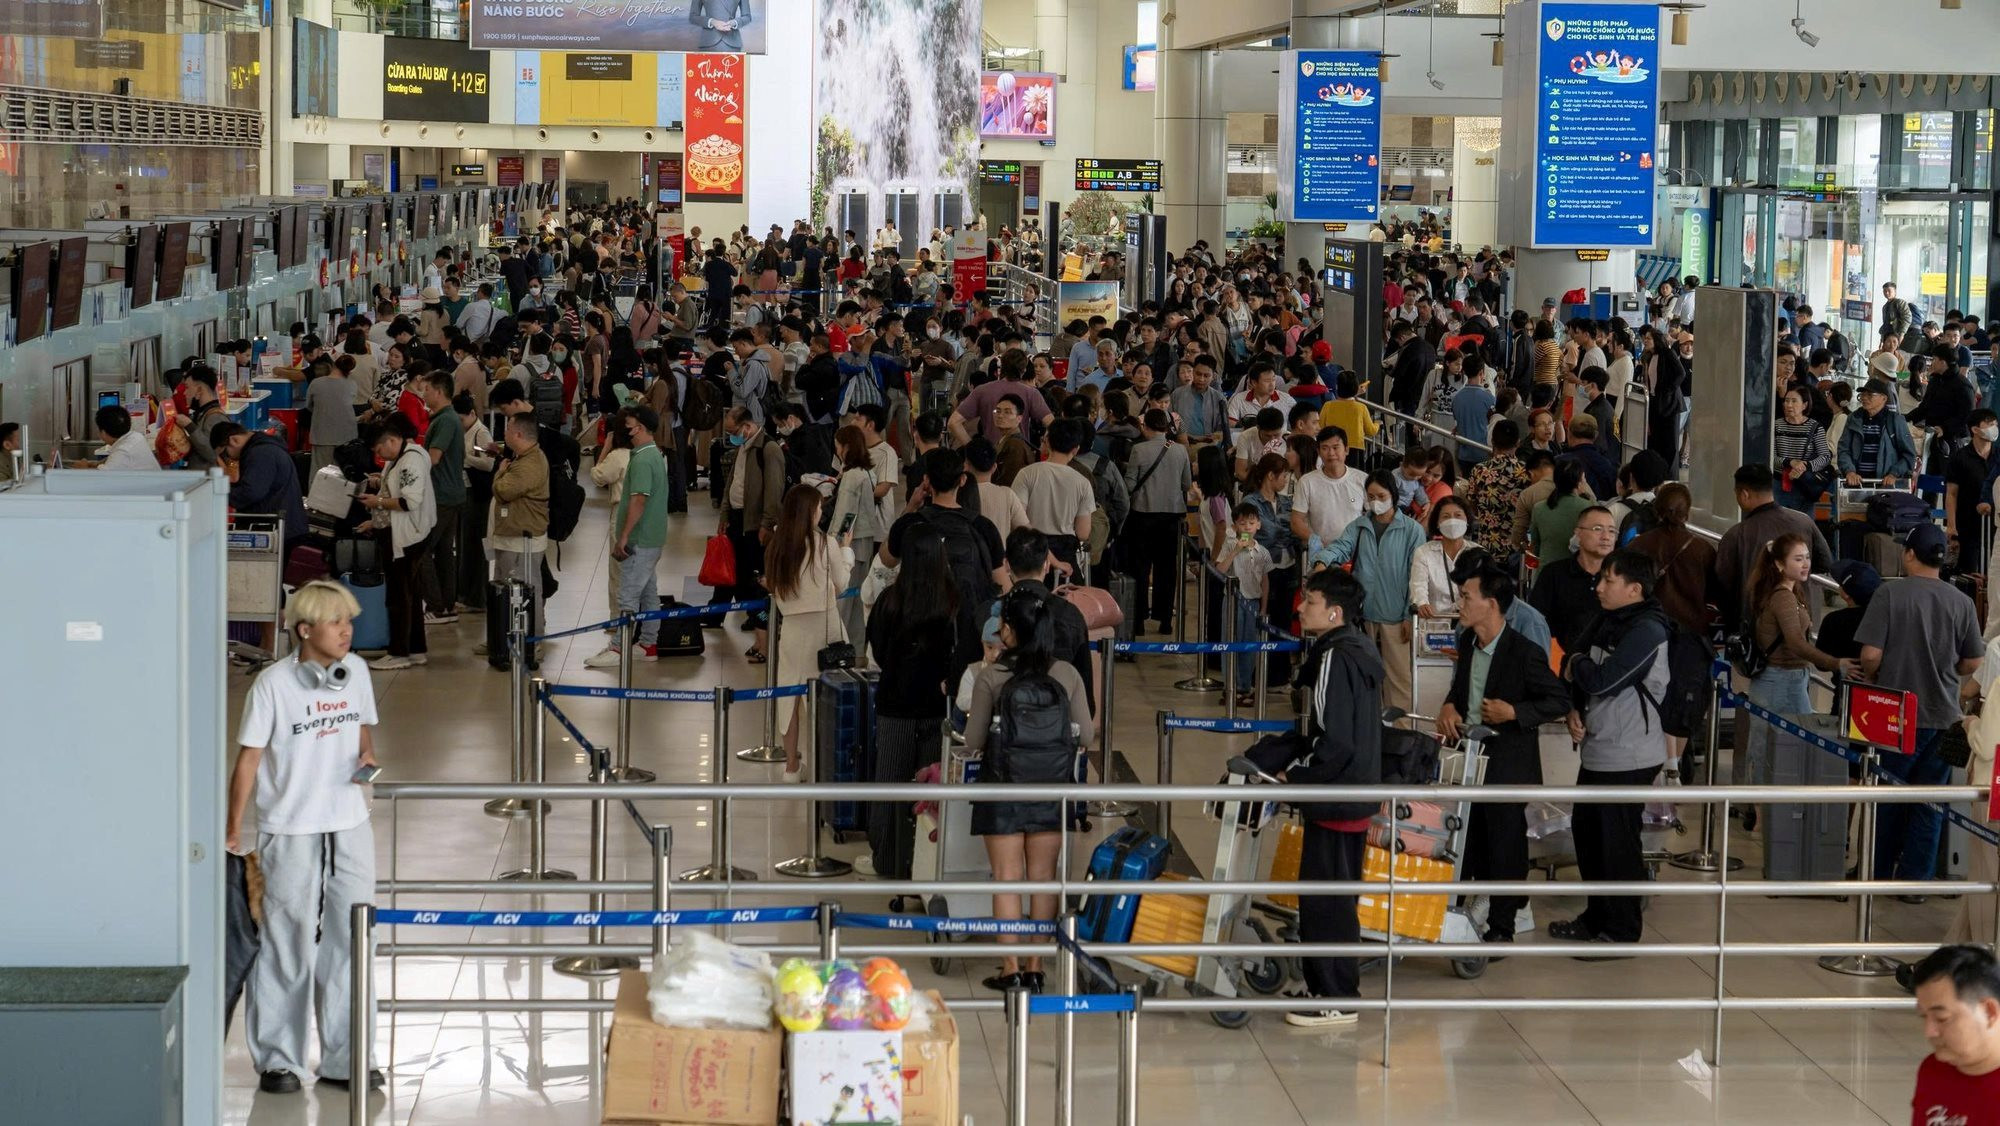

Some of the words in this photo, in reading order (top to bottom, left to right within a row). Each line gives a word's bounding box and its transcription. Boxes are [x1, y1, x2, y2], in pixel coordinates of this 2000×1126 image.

[525, 4, 564, 18] BƯỚC
[387, 62, 404, 78] CỬA
[406, 66, 416, 79] RA
[418, 64, 432, 80] TÀU
[434, 68, 448, 81] BAY
[387, 83, 408, 94] Boarding
[408, 84, 422, 94] Gates
[452, 72, 473, 93] 1-12
[1924, 118, 1936, 130] A
[1904, 134, 1912, 148] 1
[1690, 212, 1702, 278] AMBOO
[1163, 643, 1180, 651] ACV
[1212, 643, 1228, 651] ACV
[670, 691, 695, 700] KHÔNG
[756, 689, 774, 698] ACV
[306, 705, 311, 716] I
[316, 700, 348, 712] love
[292, 712, 360, 736] Everyone
[413, 912, 441, 923] ACV
[493, 914, 522, 924] ACV
[573, 914, 600, 924] ACV
[652, 912, 680, 924] ACV
[732, 910, 759, 922] ACV
[888, 918, 913, 928] N.I.A
[1000, 922, 1036, 933] KHÔNG
[1064, 1000, 1089, 1010] N.I.A
